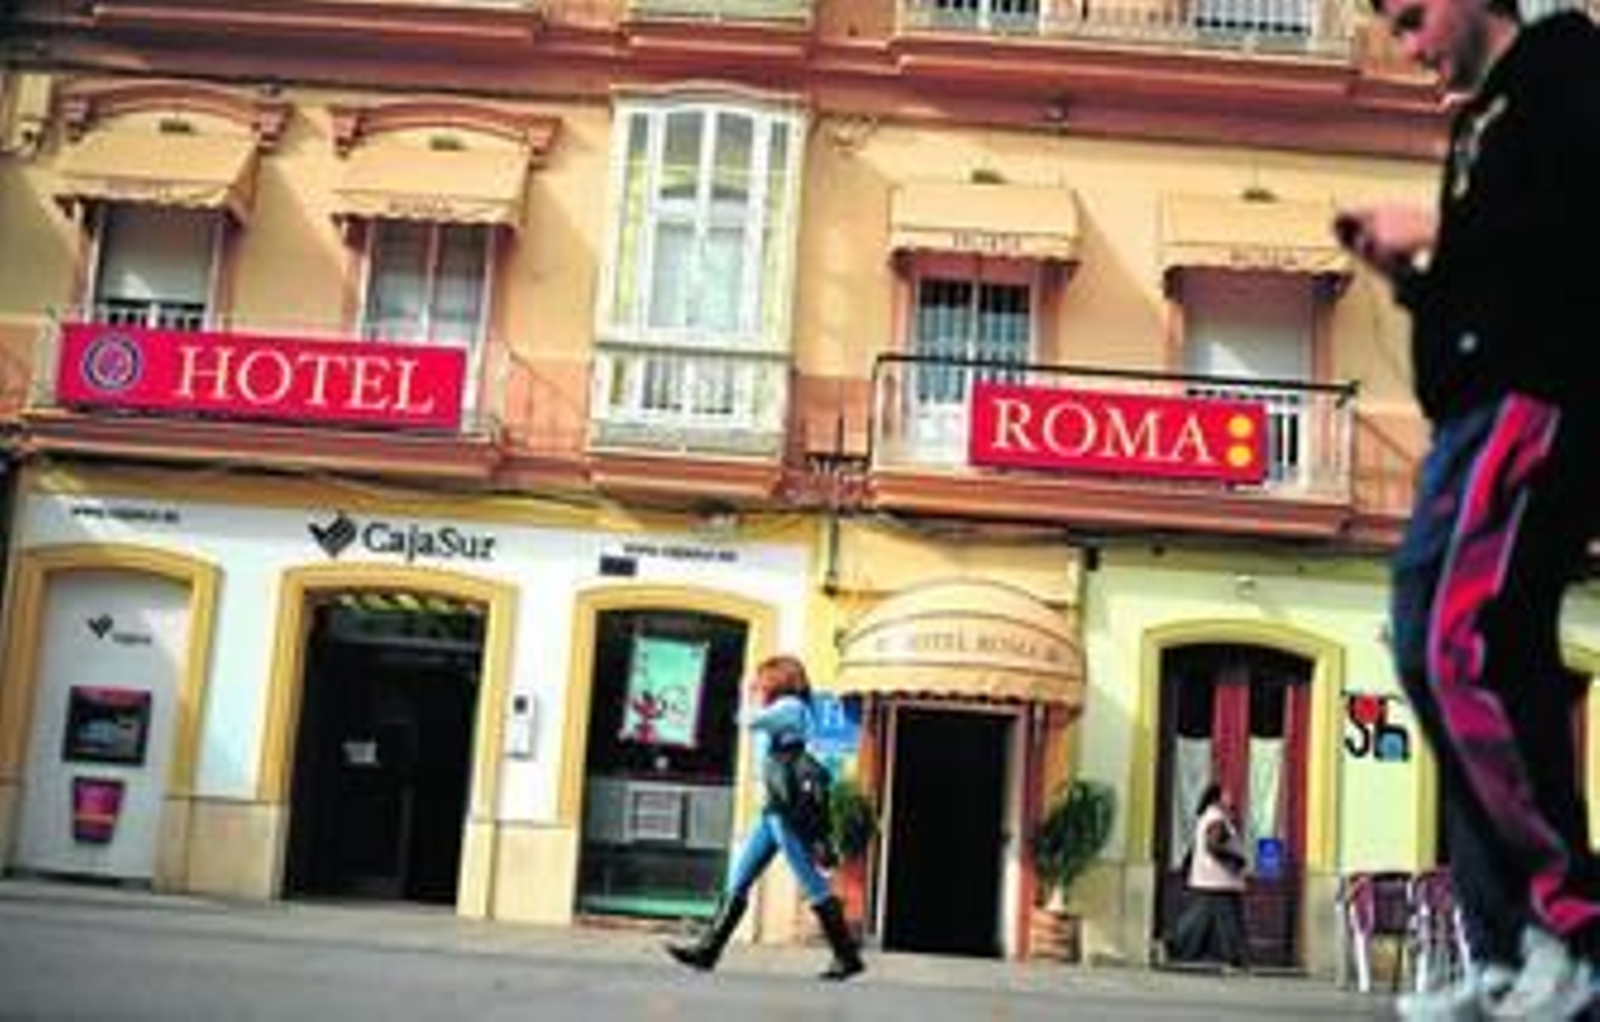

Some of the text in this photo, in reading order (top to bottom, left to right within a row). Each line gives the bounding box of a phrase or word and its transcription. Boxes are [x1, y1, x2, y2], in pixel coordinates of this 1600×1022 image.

[175, 344, 436, 415] HOTEL
[991, 399, 1215, 466] ROMA
[362, 520, 497, 563] CajaSur
